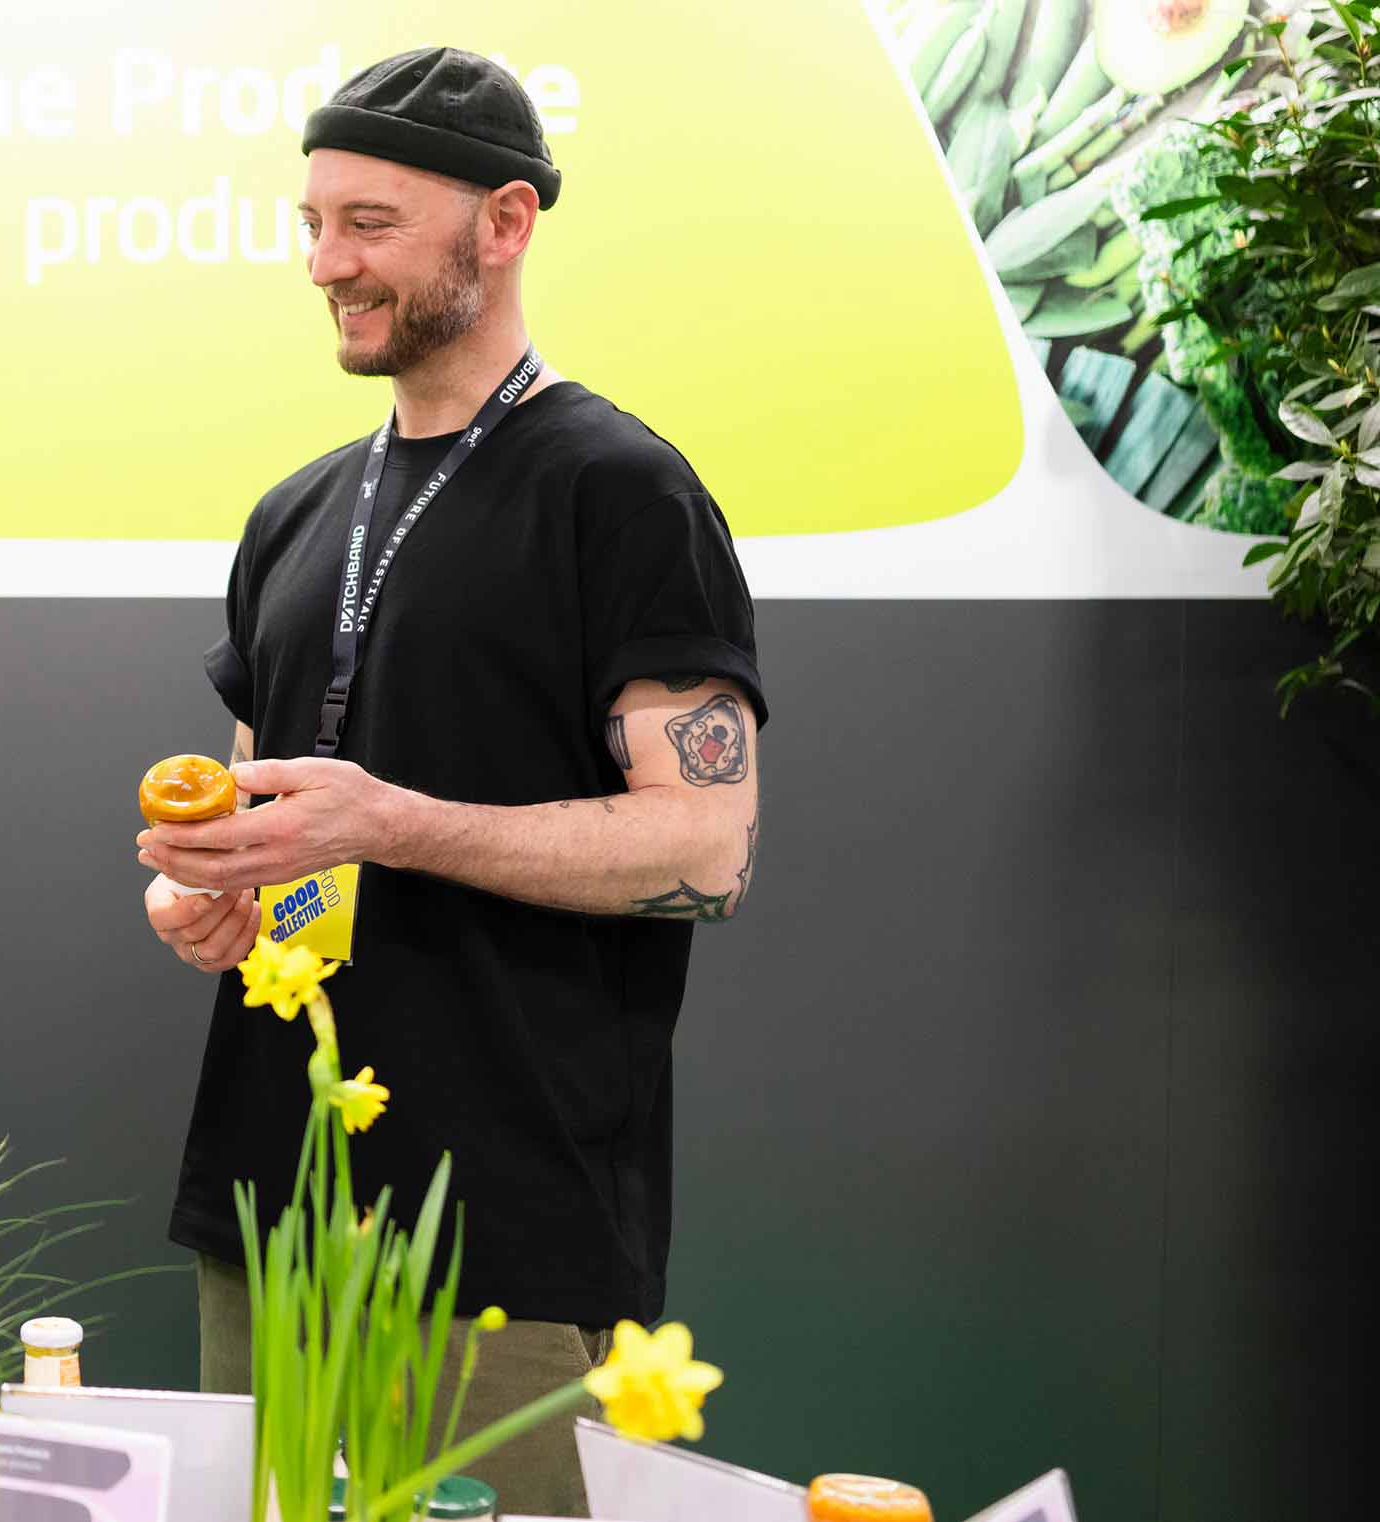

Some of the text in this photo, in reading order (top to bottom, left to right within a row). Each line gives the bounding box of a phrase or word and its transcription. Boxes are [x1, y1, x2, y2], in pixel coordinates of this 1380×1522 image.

[110, 44, 578, 138] Prode
[357, 472, 447, 633] FUTURE OF FESTIVALS
[270, 896, 326, 943] COLLECTIVE
[273, 879, 320, 922] GOOD
